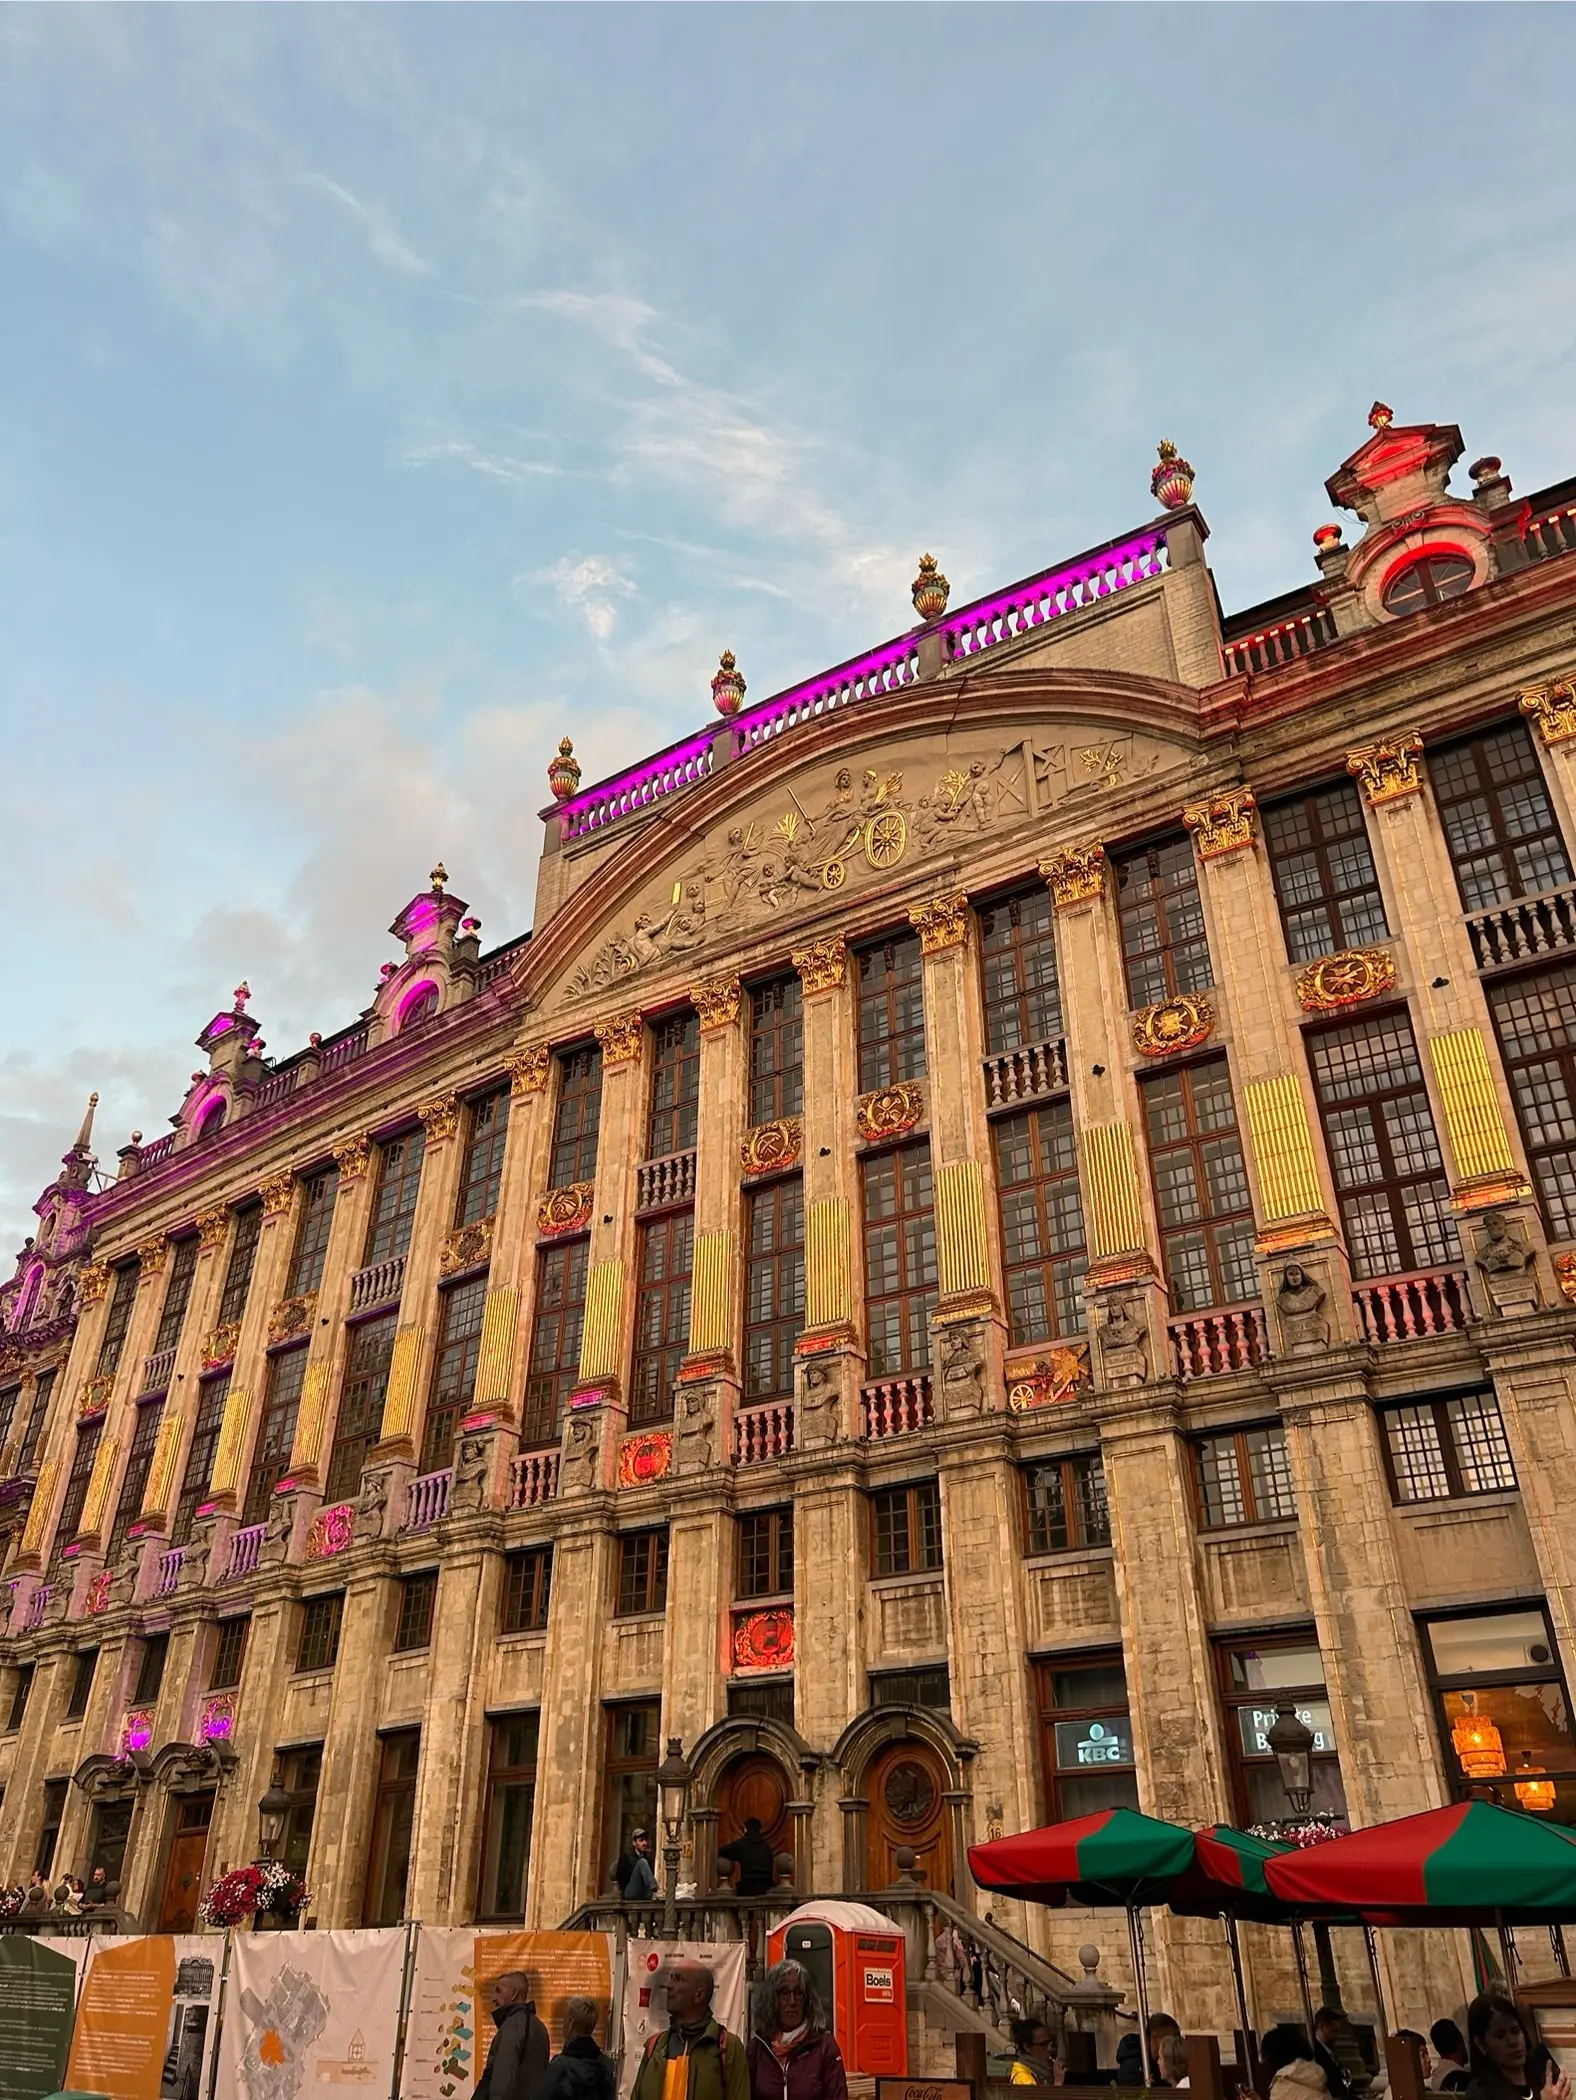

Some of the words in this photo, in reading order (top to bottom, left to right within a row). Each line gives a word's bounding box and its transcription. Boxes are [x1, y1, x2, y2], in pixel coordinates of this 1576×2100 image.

[1253, 1709, 1312, 1728] Prite
[1078, 1746, 1120, 1763] KBC
[990, 1827, 1001, 1840] 16
[866, 1973, 891, 1987] Boels
